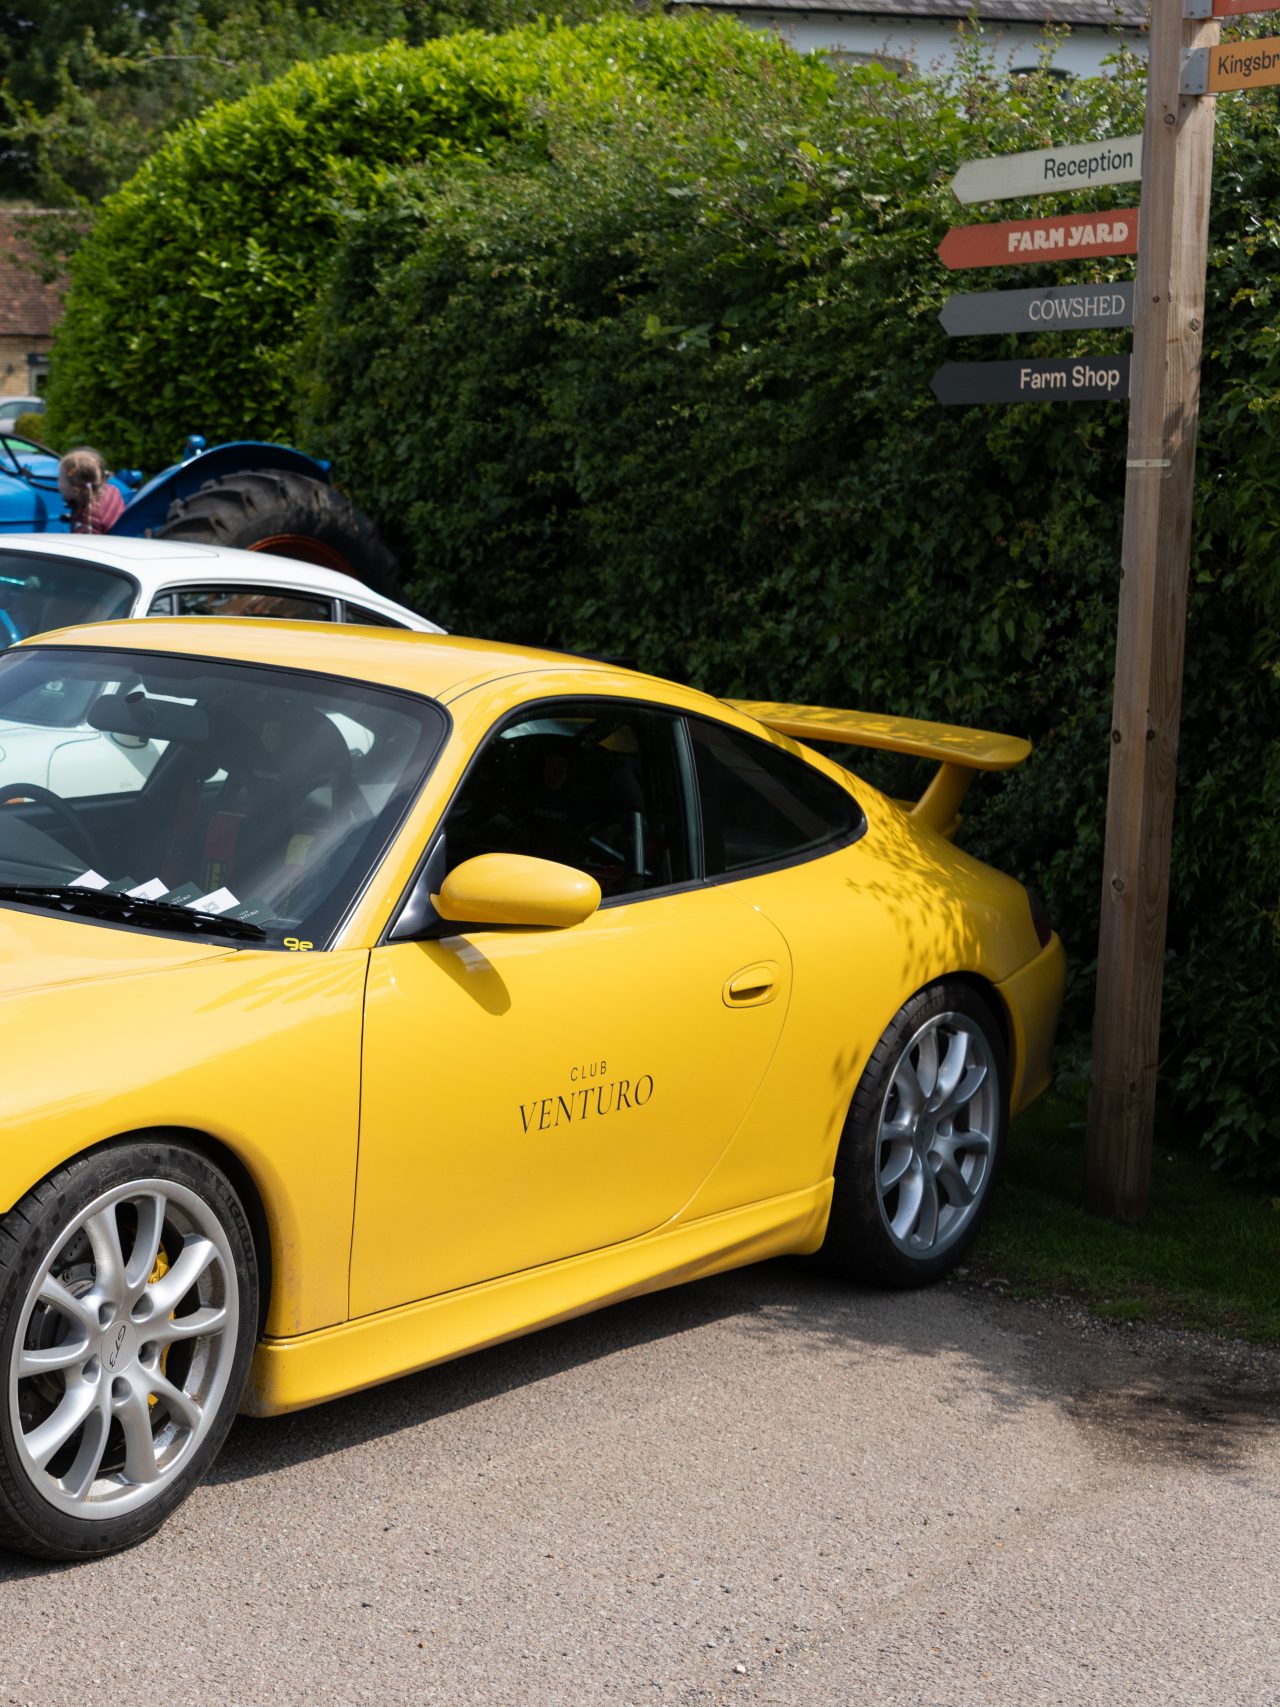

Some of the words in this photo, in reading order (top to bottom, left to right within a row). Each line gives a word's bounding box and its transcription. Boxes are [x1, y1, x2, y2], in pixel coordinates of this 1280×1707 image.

[1217, 51, 1280, 77] Kingsbr
[1044, 149, 1133, 180] Reception
[1008, 228, 1064, 252] FARM
[1068, 222, 1128, 247] YARD
[1029, 294, 1125, 321] COWSHED
[1020, 367, 1066, 390] Farm
[1072, 365, 1120, 391] Shop
[570, 1060, 607, 1082] CLUB
[519, 1074, 654, 1134] VENTURO
